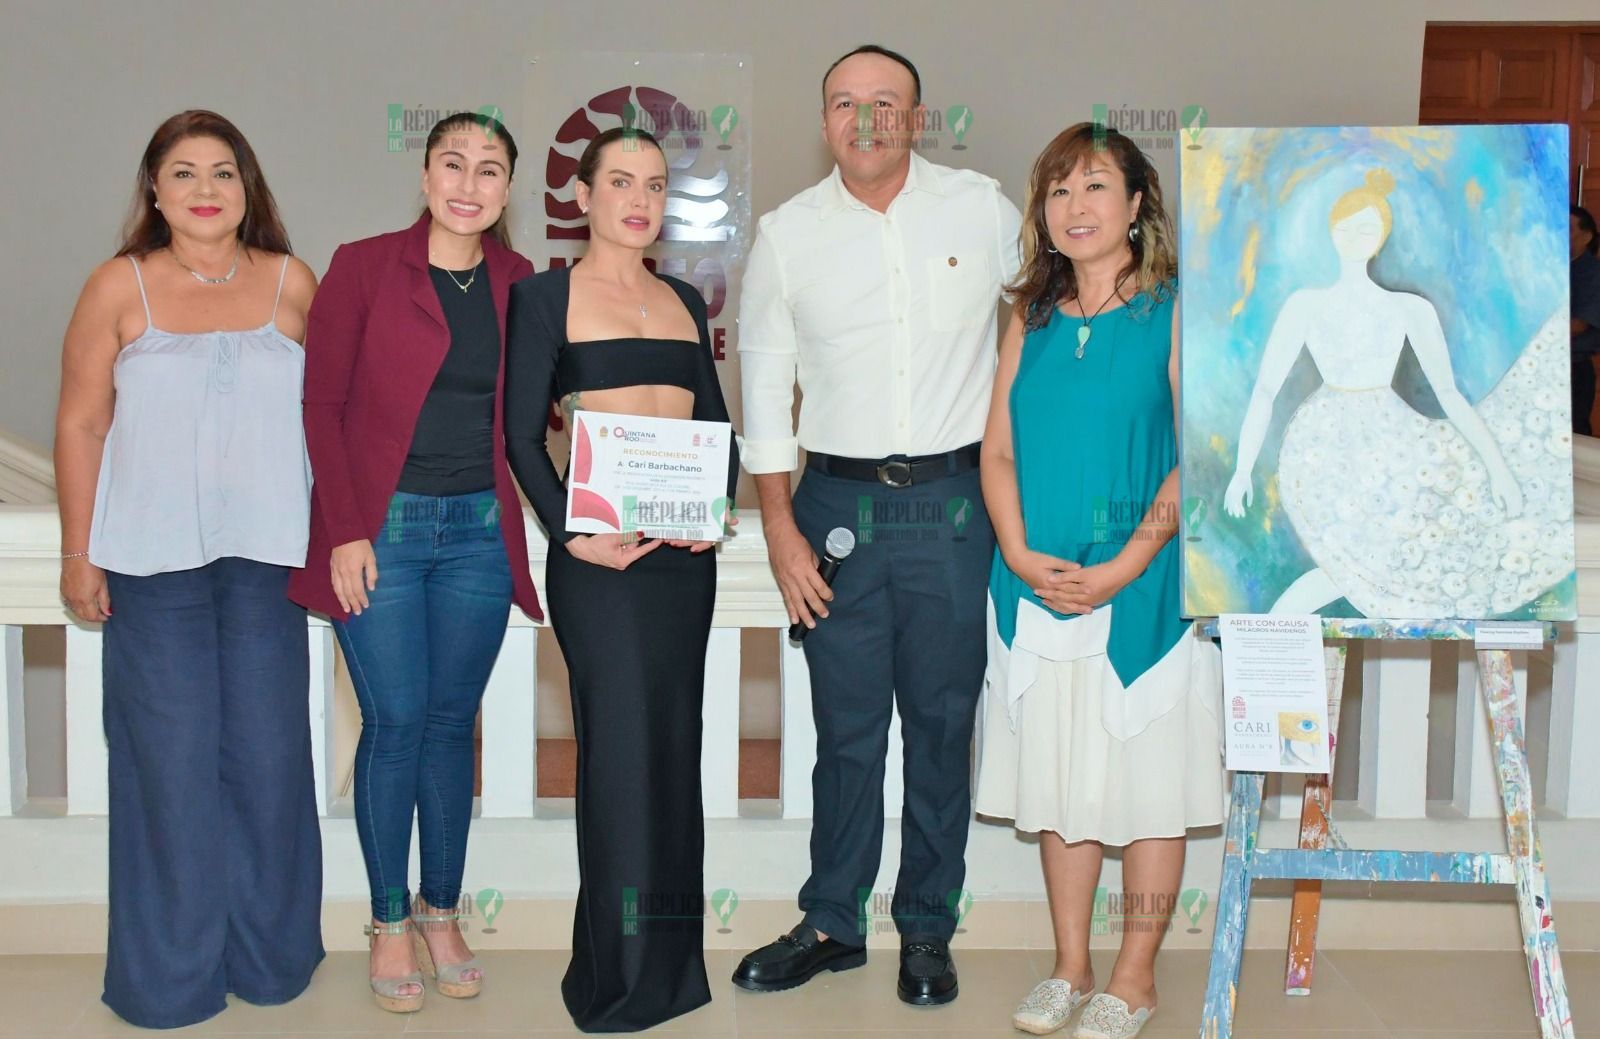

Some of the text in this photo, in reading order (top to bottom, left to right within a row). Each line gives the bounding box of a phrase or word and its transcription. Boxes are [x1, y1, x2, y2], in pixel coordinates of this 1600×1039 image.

[613, 426, 656, 438] QUINTANA
[623, 448, 698, 460] RECONOCIMIENTO
[628, 460, 646, 469] Cari
[648, 462, 702, 473] Barbachano
[1230, 619, 1309, 628] ARTE CON CAUSA
[1234, 721, 1271, 733] CARI
